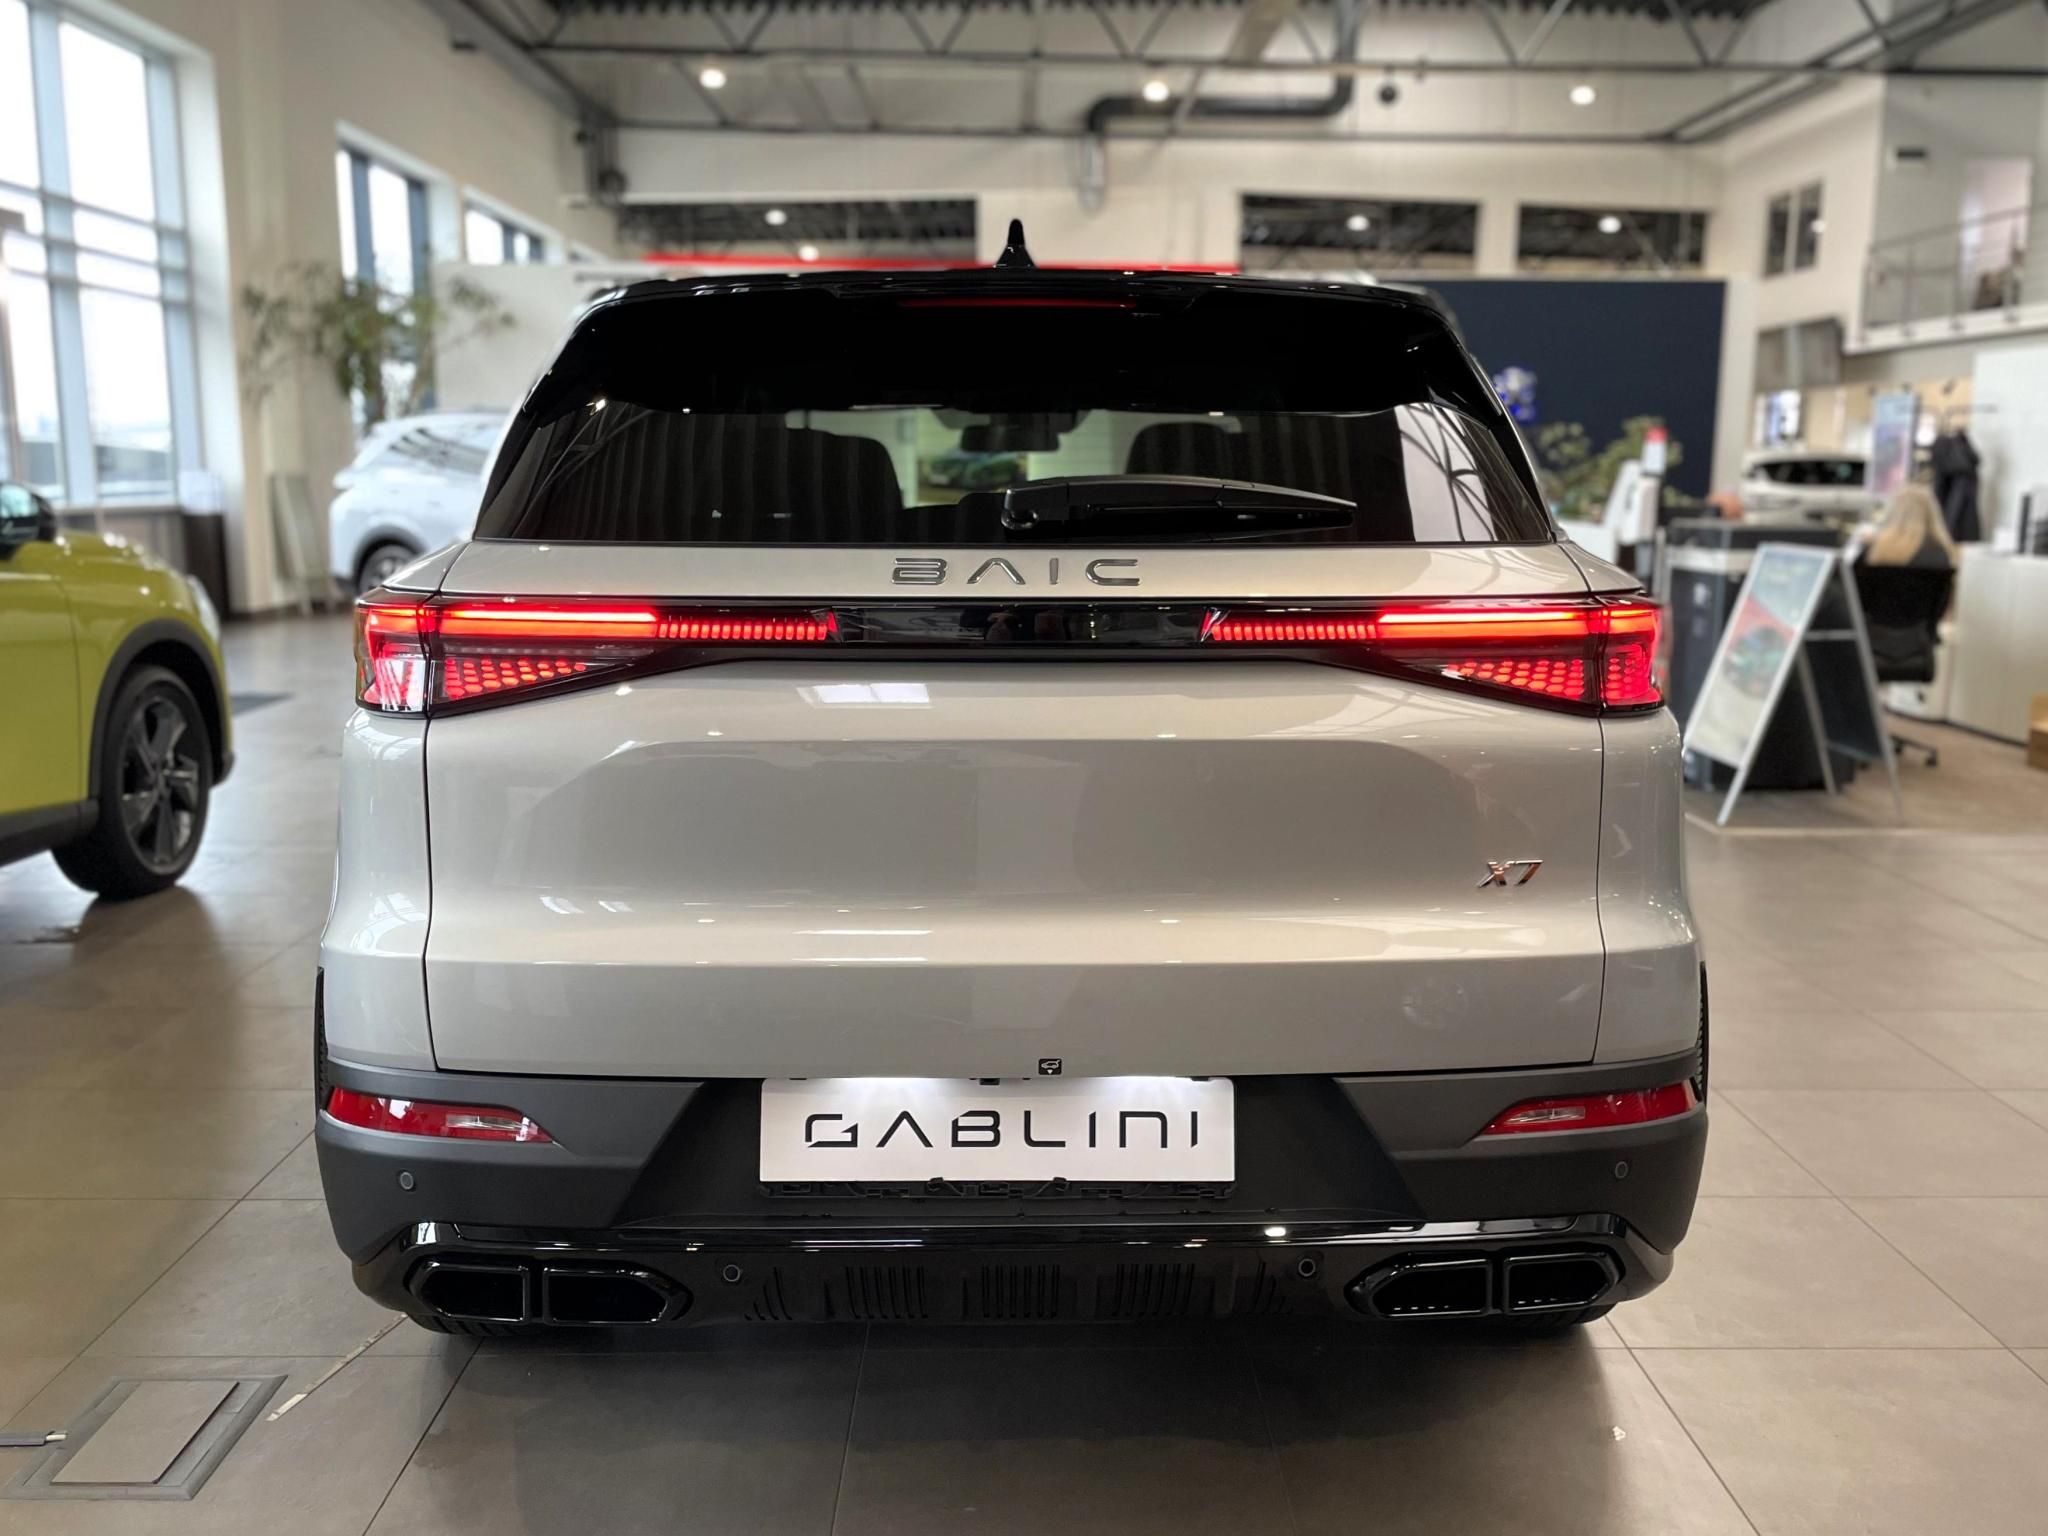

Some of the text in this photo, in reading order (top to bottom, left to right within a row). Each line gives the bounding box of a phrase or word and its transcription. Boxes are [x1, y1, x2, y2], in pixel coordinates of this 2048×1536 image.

[892, 557, 1140, 586] BAIC
[1477, 859, 1543, 888] X7
[805, 1110, 1198, 1148] GABLINI
